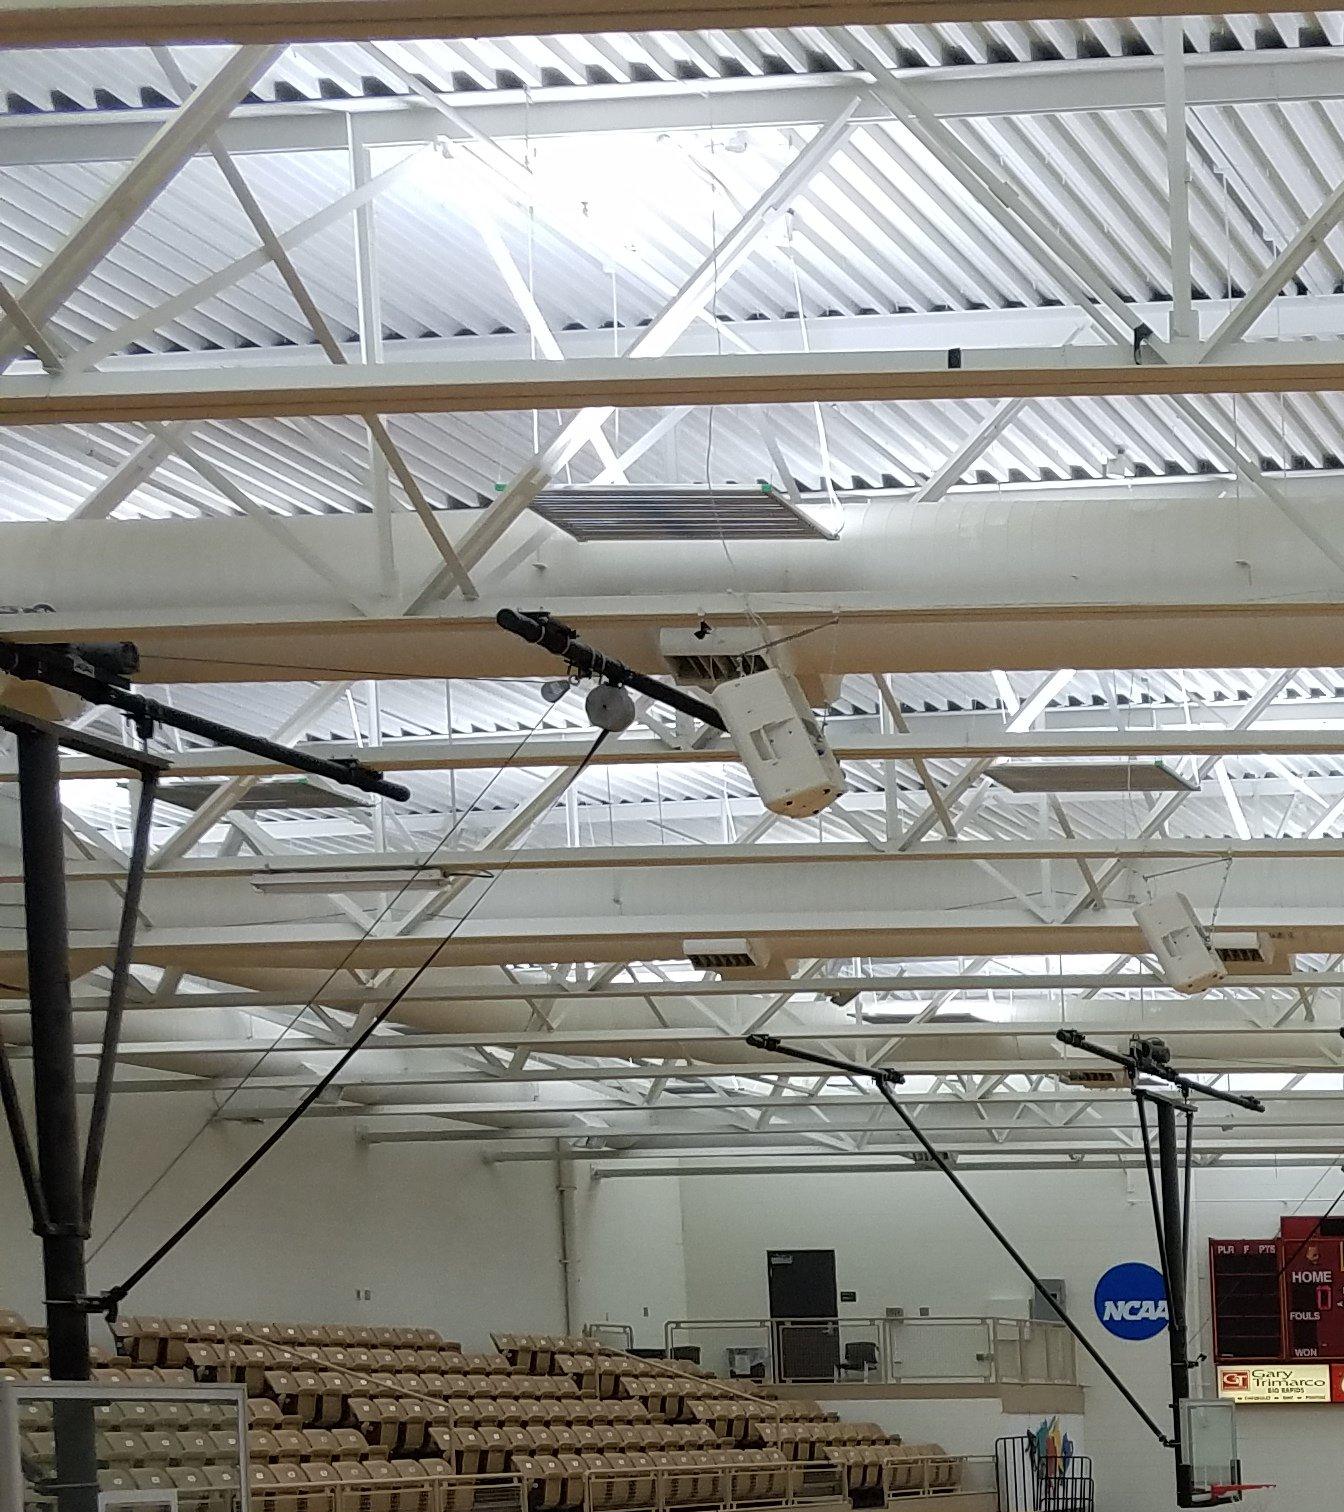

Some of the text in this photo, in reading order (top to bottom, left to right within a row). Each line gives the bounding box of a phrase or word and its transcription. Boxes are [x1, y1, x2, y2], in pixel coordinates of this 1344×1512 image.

[1217, 1245, 1235, 1254] PLR
[1292, 1271, 1332, 1283] HOME
[1103, 1300, 1170, 1321] NCAA
[1289, 1311, 1321, 1320] FOULS
[1294, 1348, 1318, 1357] WON
[1251, 1369, 1293, 1380] Gary
[1252, 1377, 1326, 1388] Trimarco
